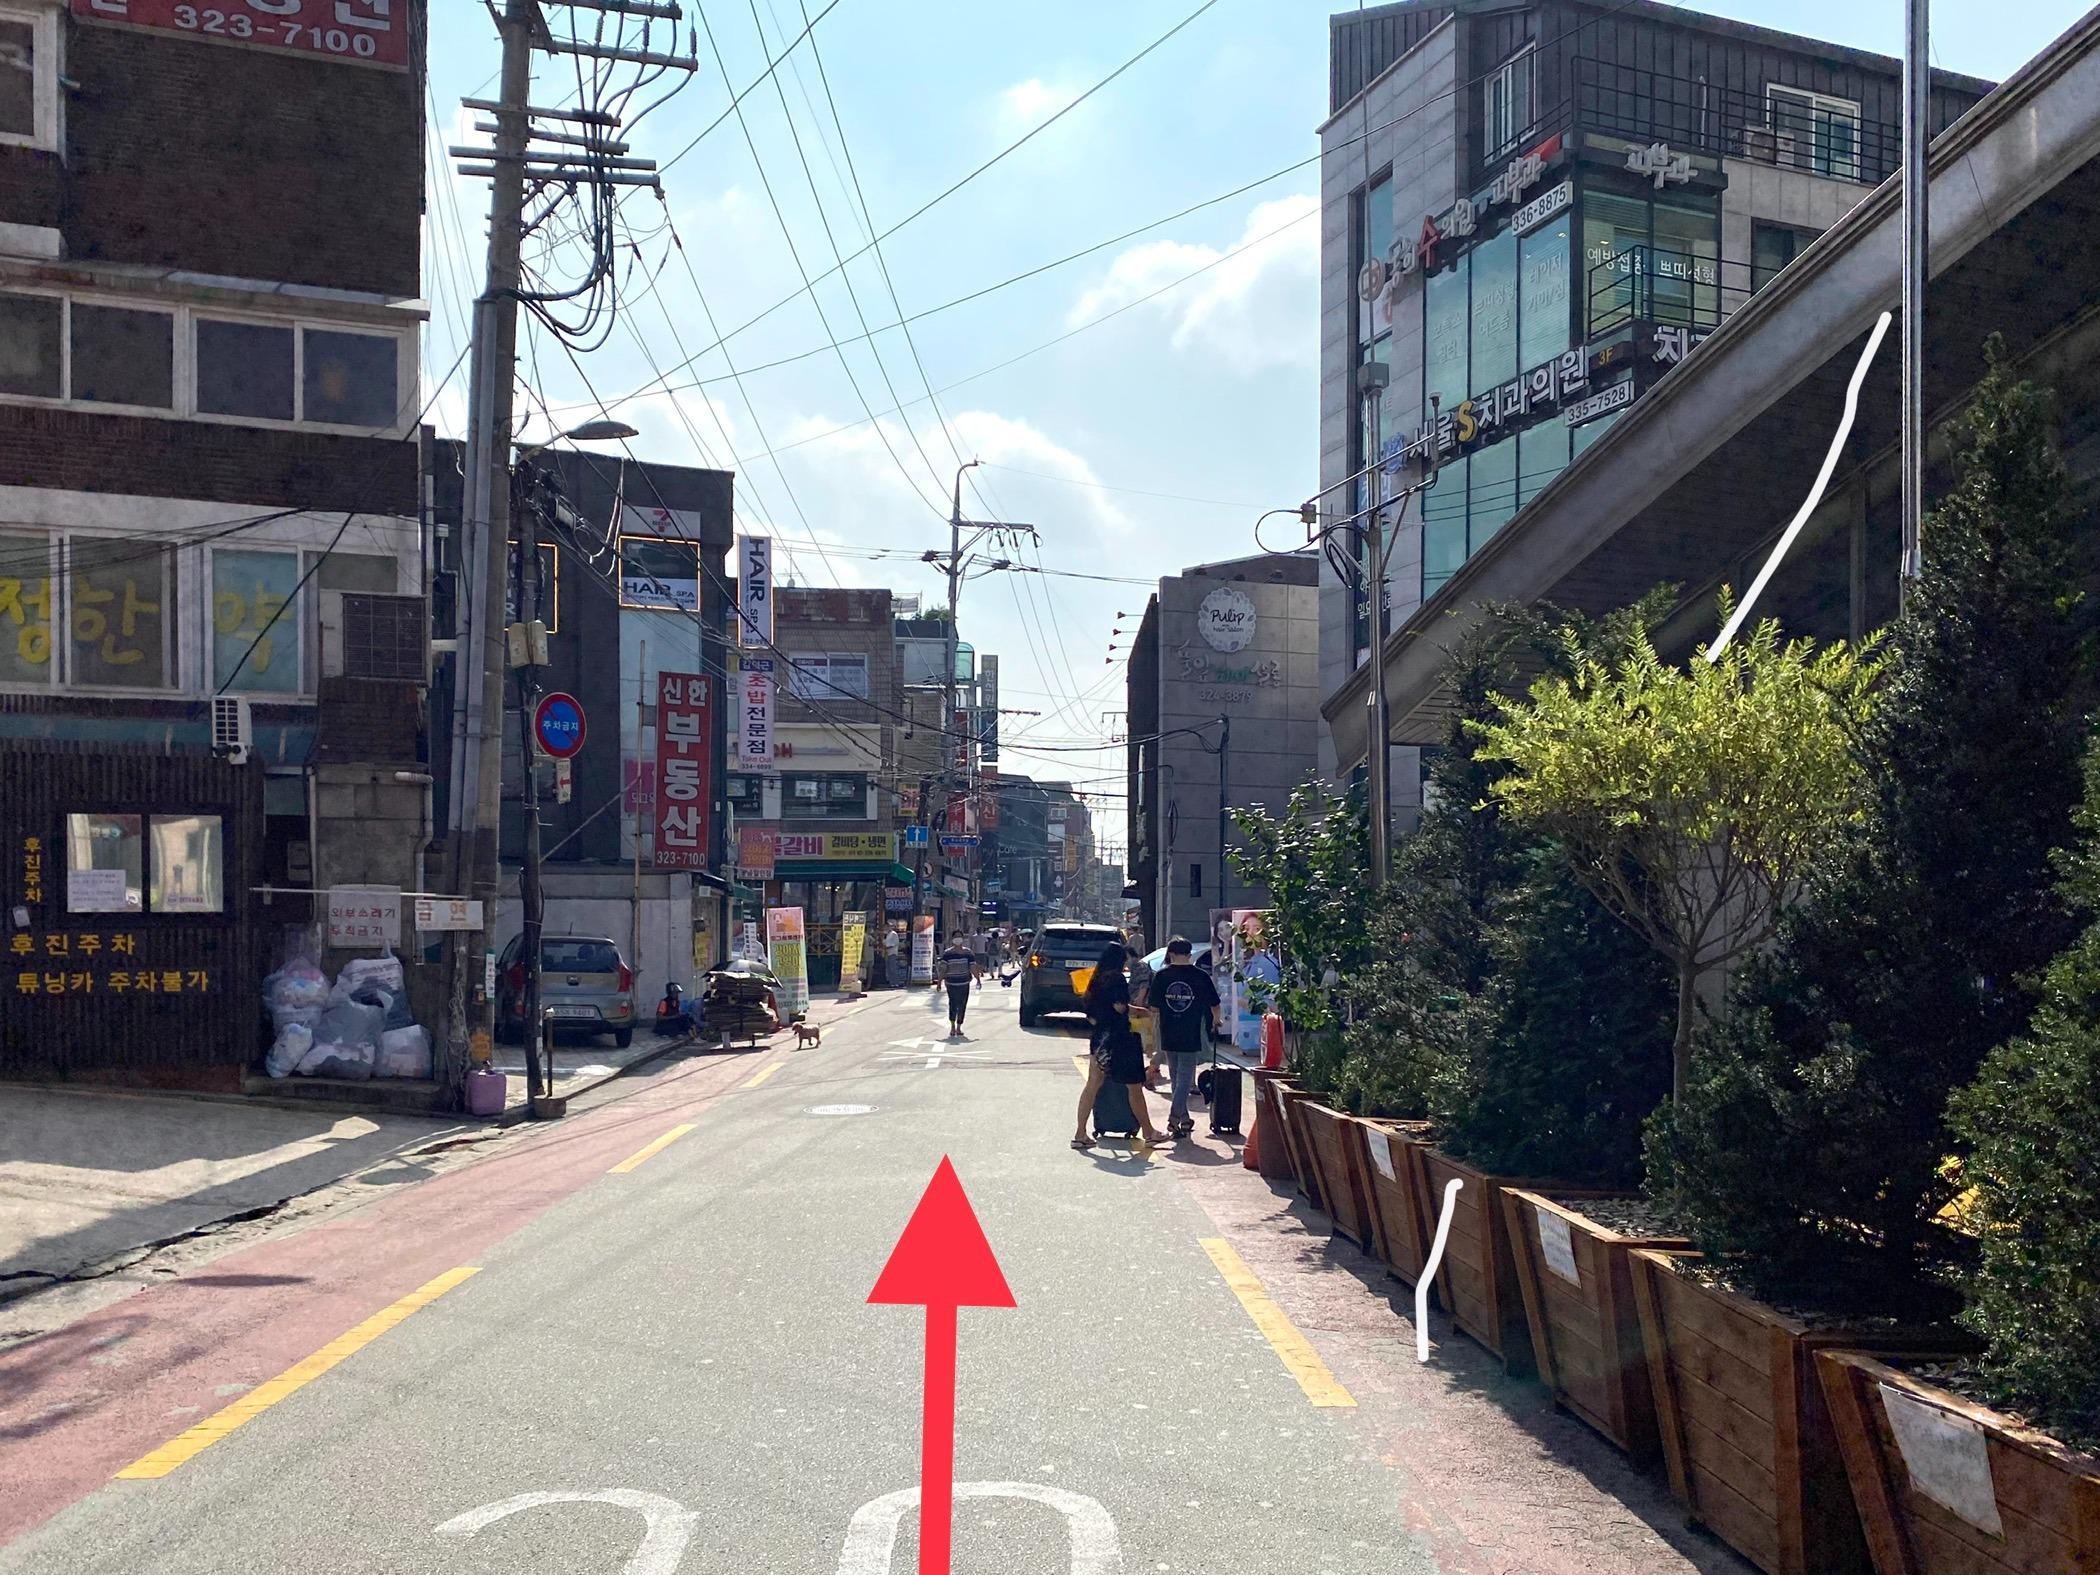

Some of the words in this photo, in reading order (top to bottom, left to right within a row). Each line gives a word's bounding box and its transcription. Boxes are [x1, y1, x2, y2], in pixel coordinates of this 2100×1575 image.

[174, 5, 375, 56] 323-7100
[1490, 152, 1548, 205] 피부과
[1623, 143, 1699, 190] 피부과
[1512, 184, 1568, 232] 336-8875
[1529, 252, 1564, 285] 레이저
[1587, 247, 1643, 276] 예방접종
[1568, 386, 1627, 423] 335-7528
[749, 536, 765, 602] HAIR
[676, 590, 695, 598] SPA
[1210, 609, 1245, 626] Pulip
[663, 677, 707, 707] 신한
[1200, 688, 1253, 701] 324-3879
[543, 721, 578, 732] 주차금지
[661, 711, 701, 847] 부동산
[24, 837, 41, 902] 후진주차
[657, 851, 706, 866] 323-7100
[108, 970, 209, 993] 주차불가
